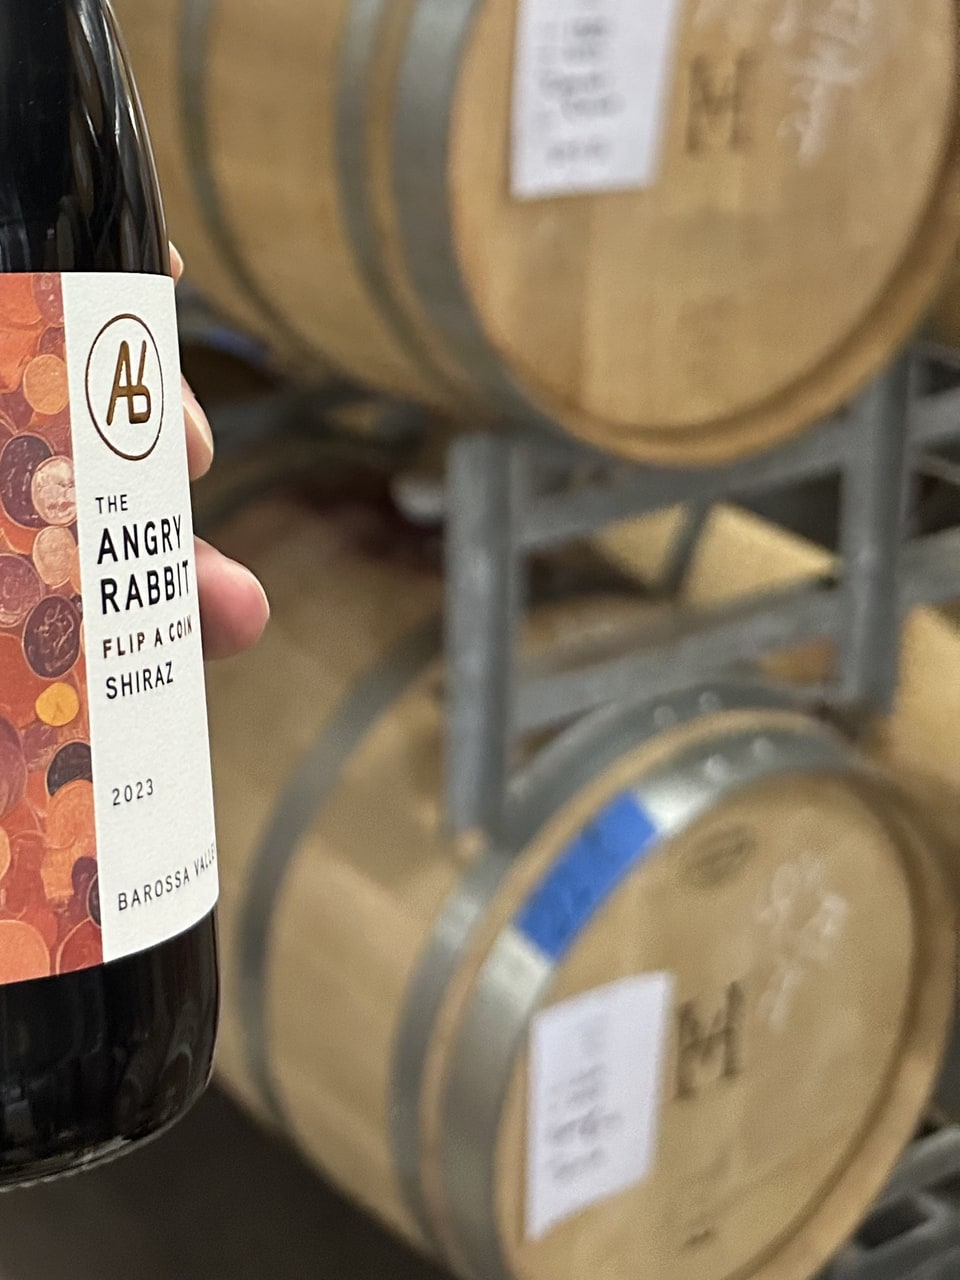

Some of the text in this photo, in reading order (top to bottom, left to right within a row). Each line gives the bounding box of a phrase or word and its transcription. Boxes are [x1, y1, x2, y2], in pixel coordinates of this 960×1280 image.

[95, 494, 128, 514] THE
[97, 514, 181, 565] ANGRY
[100, 559, 189, 615] RABBIT
[102, 614, 193, 659] FLIP A COIN
[105, 661, 174, 700] SHIRAZ
[112, 778, 154, 807] 2023
[118, 841, 215, 912] BAROSSA VALLE
